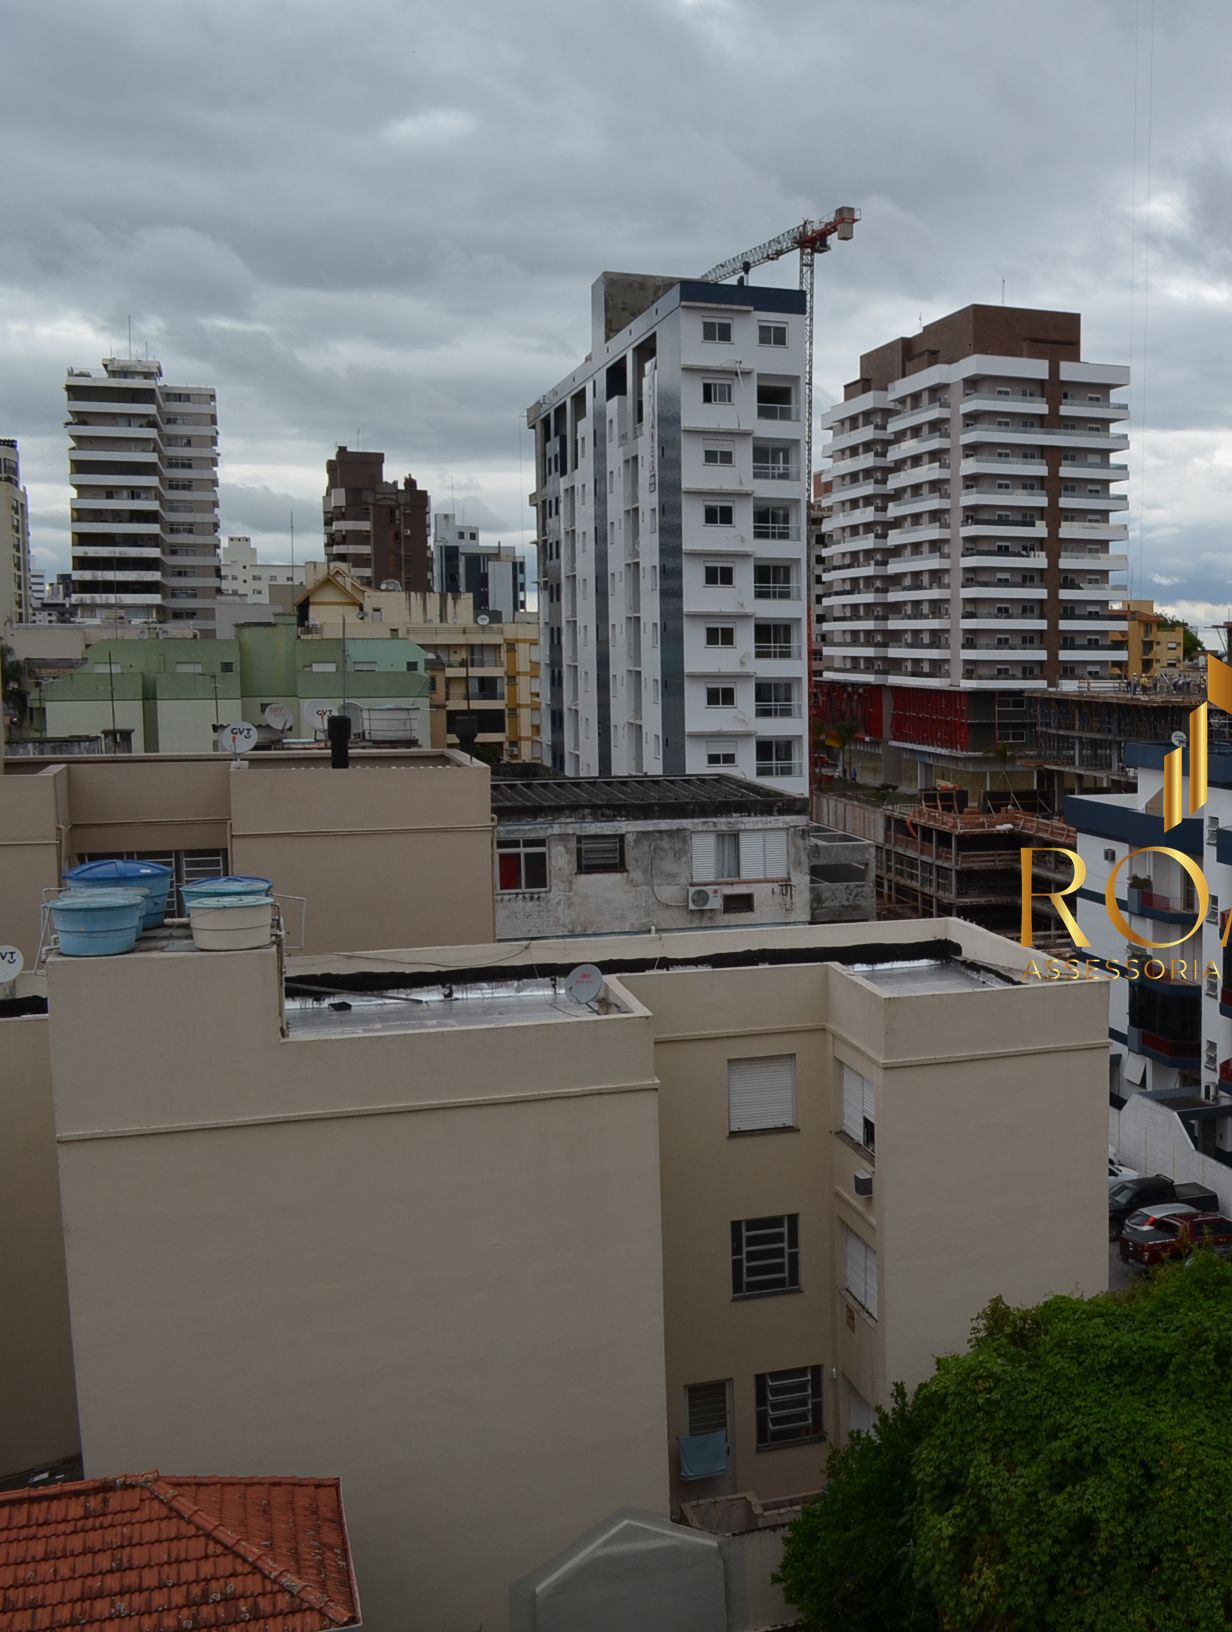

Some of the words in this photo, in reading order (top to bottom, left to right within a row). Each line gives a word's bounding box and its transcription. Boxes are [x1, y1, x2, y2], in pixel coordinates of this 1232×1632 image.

[315, 709, 333, 717] GVT
[230, 728, 252, 737] GVT
[0, 951, 16, 960] VT
